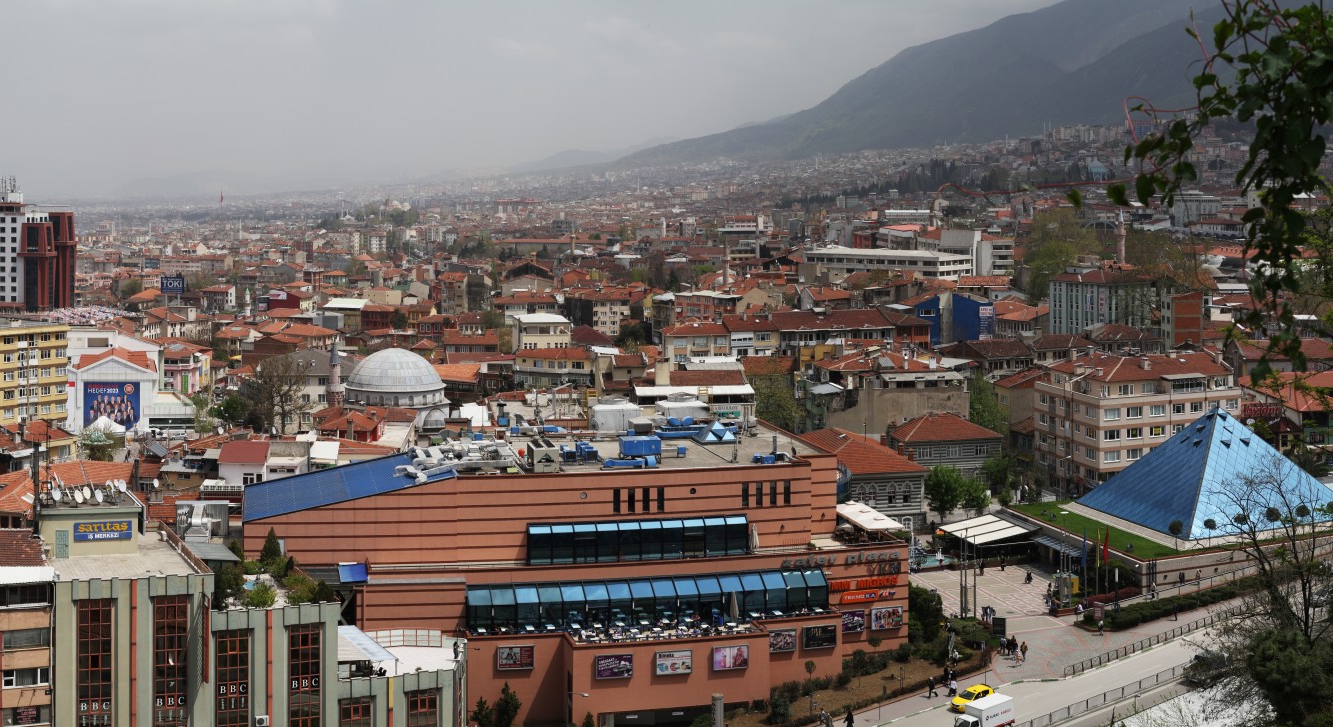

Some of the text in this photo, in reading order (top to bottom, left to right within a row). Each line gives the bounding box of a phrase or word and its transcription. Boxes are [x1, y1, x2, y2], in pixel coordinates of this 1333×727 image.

[781, 550, 902, 567] zafer plaza
[869, 561, 902, 574] YKM
[292, 678, 319, 689] BBC
[220, 684, 247, 694] BBC
[80, 701, 110, 711] BBC
[156, 697, 185, 707] BBC
